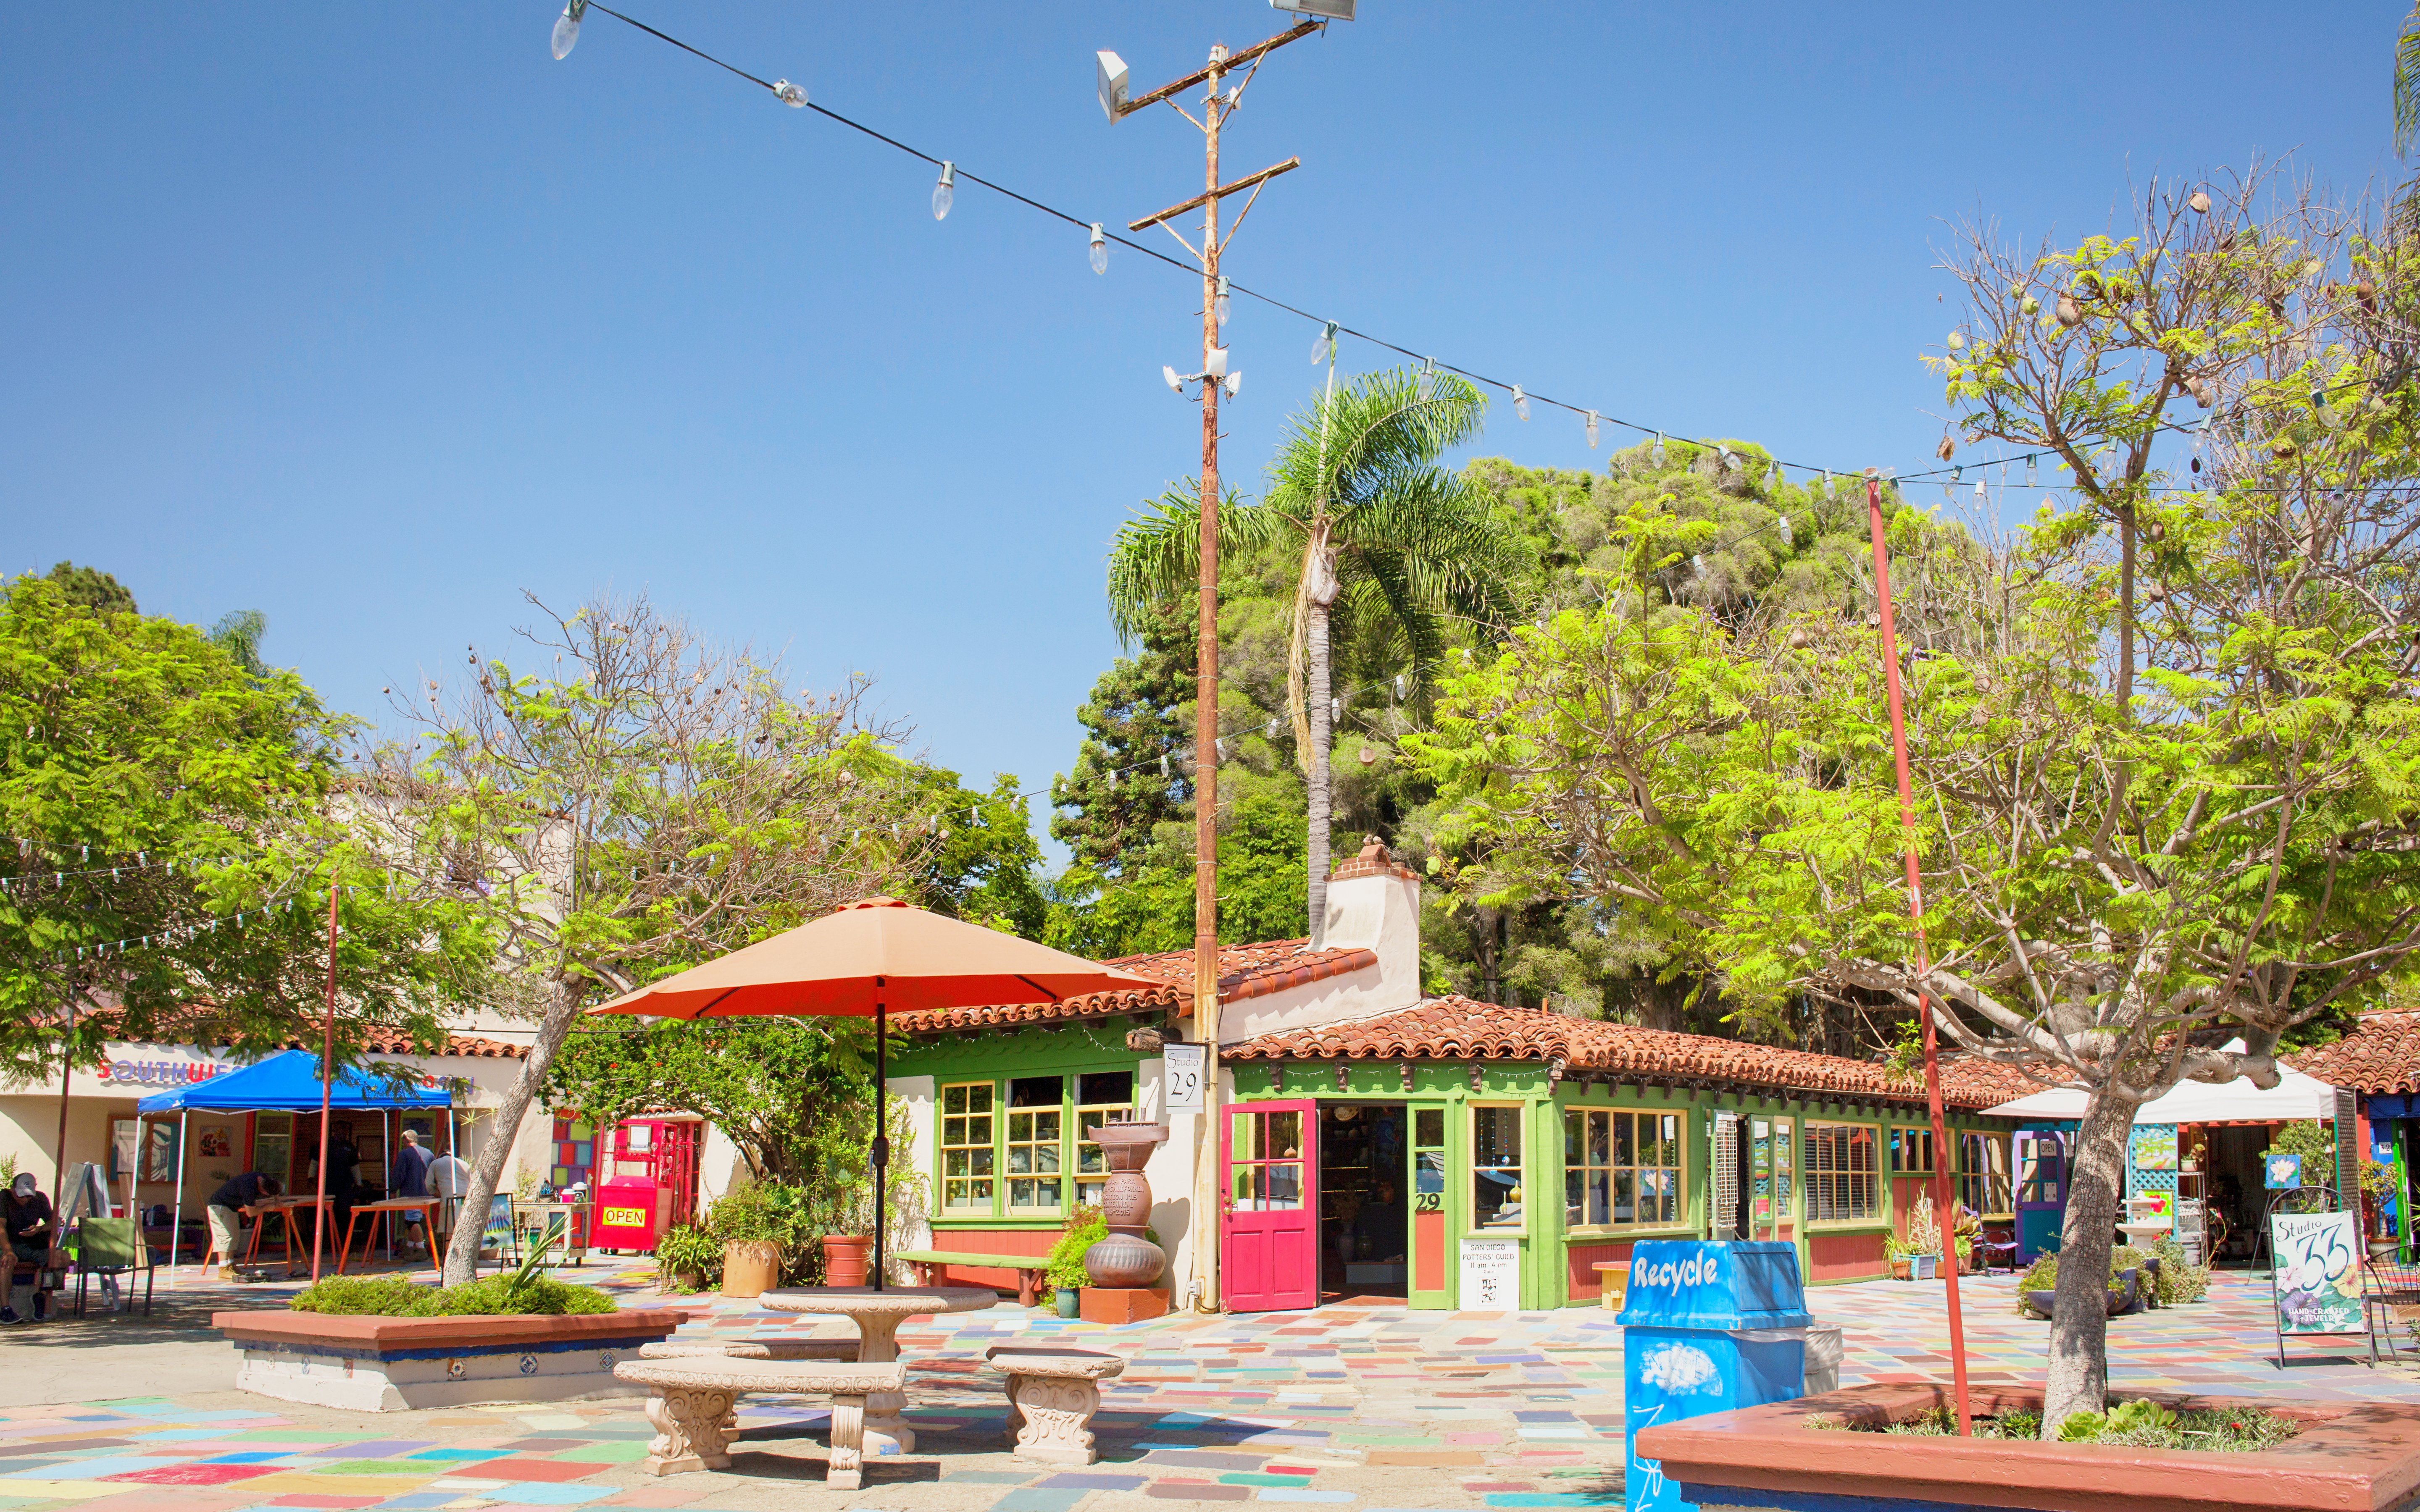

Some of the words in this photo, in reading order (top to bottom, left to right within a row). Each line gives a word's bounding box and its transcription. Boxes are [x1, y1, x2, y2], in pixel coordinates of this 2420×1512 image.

[1167, 1053, 1198, 1068] Studio
[1171, 1072, 1196, 1102] 29
[2041, 1143, 2054, 1152] OPEN
[1416, 1193, 1440, 1211] 29
[606, 1210, 643, 1223] OPEN
[2276, 1220, 2322, 1242] Studio
[2296, 1223, 2349, 1292] 33
[1634, 1248, 1717, 1297] Recycle
